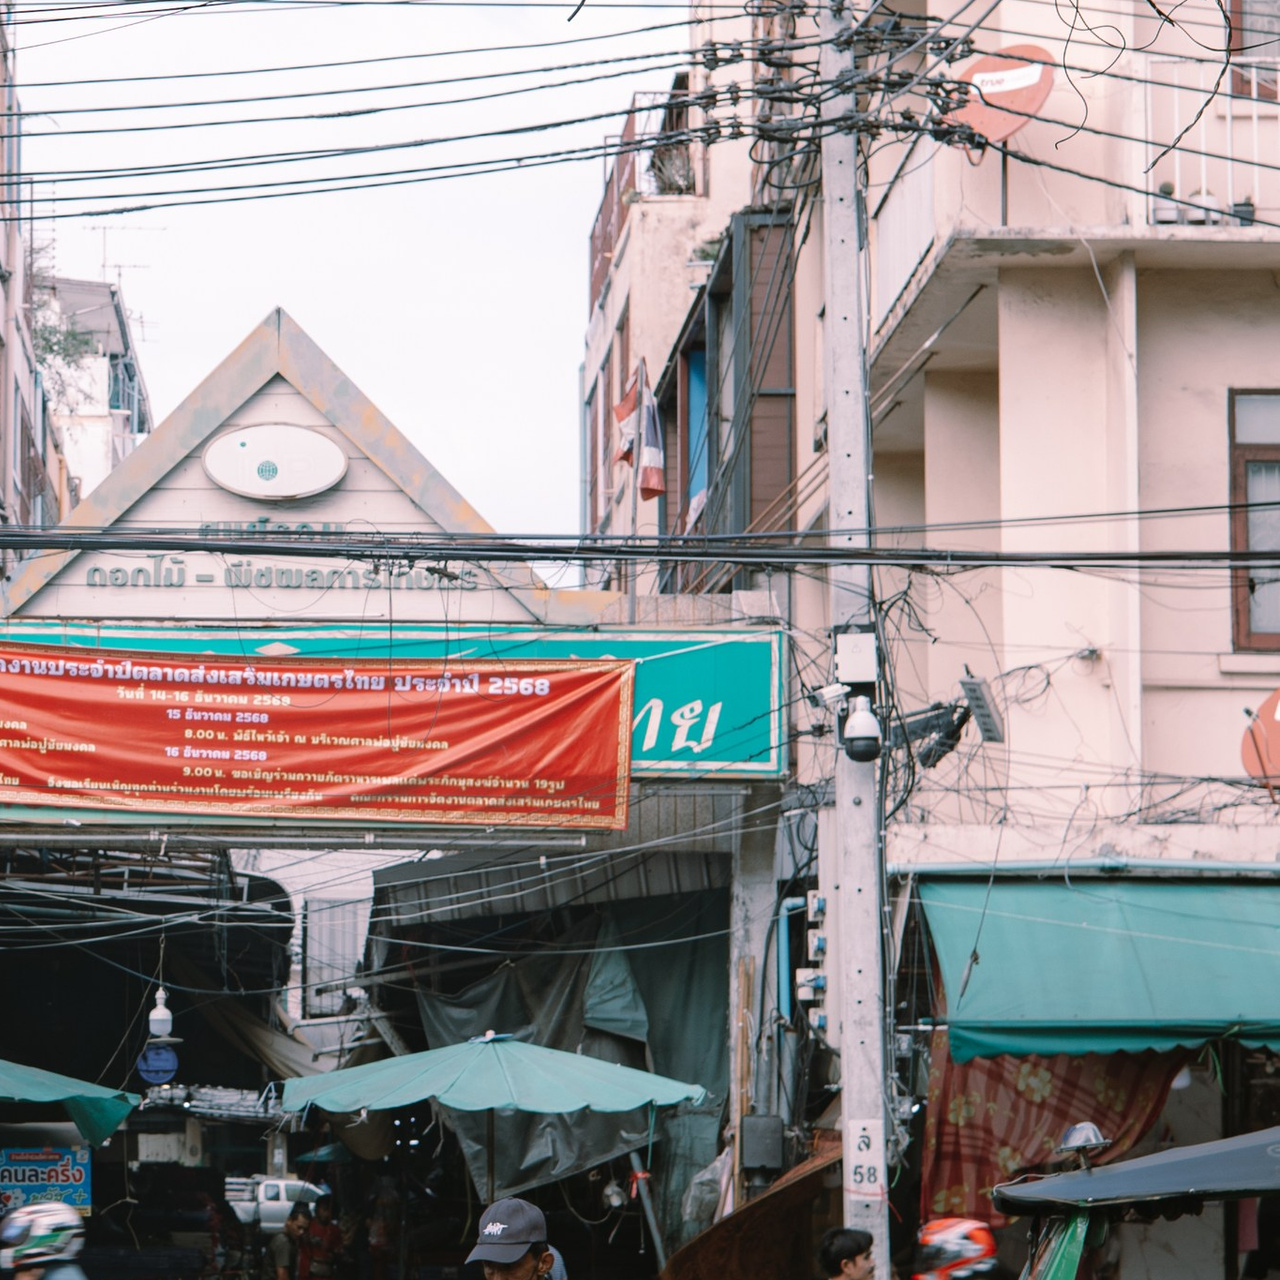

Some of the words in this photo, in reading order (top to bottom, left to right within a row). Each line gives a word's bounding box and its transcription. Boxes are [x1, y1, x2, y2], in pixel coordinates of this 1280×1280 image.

[86, 556, 187, 588] ดอกไม้
[117, 683, 145, 700] วันที่
[150, 689, 190, 703] 14-16
[194, 690, 249, 705] ธันวาคม
[488, 676, 551, 697] 2568
[166, 708, 182, 720] 15
[185, 708, 232, 723] ธันวาคม
[235, 712, 270, 724] 2568
[184, 728, 215, 739] 8.00
[165, 746, 180, 758] 16
[183, 745, 230, 760] ธันวาคม
[234, 750, 268, 762] 2568
[182, 766, 213, 777] 9.00
[0, 1157, 84, 1183] คนละครึ่ง
[853, 1165, 878, 1184] 58
